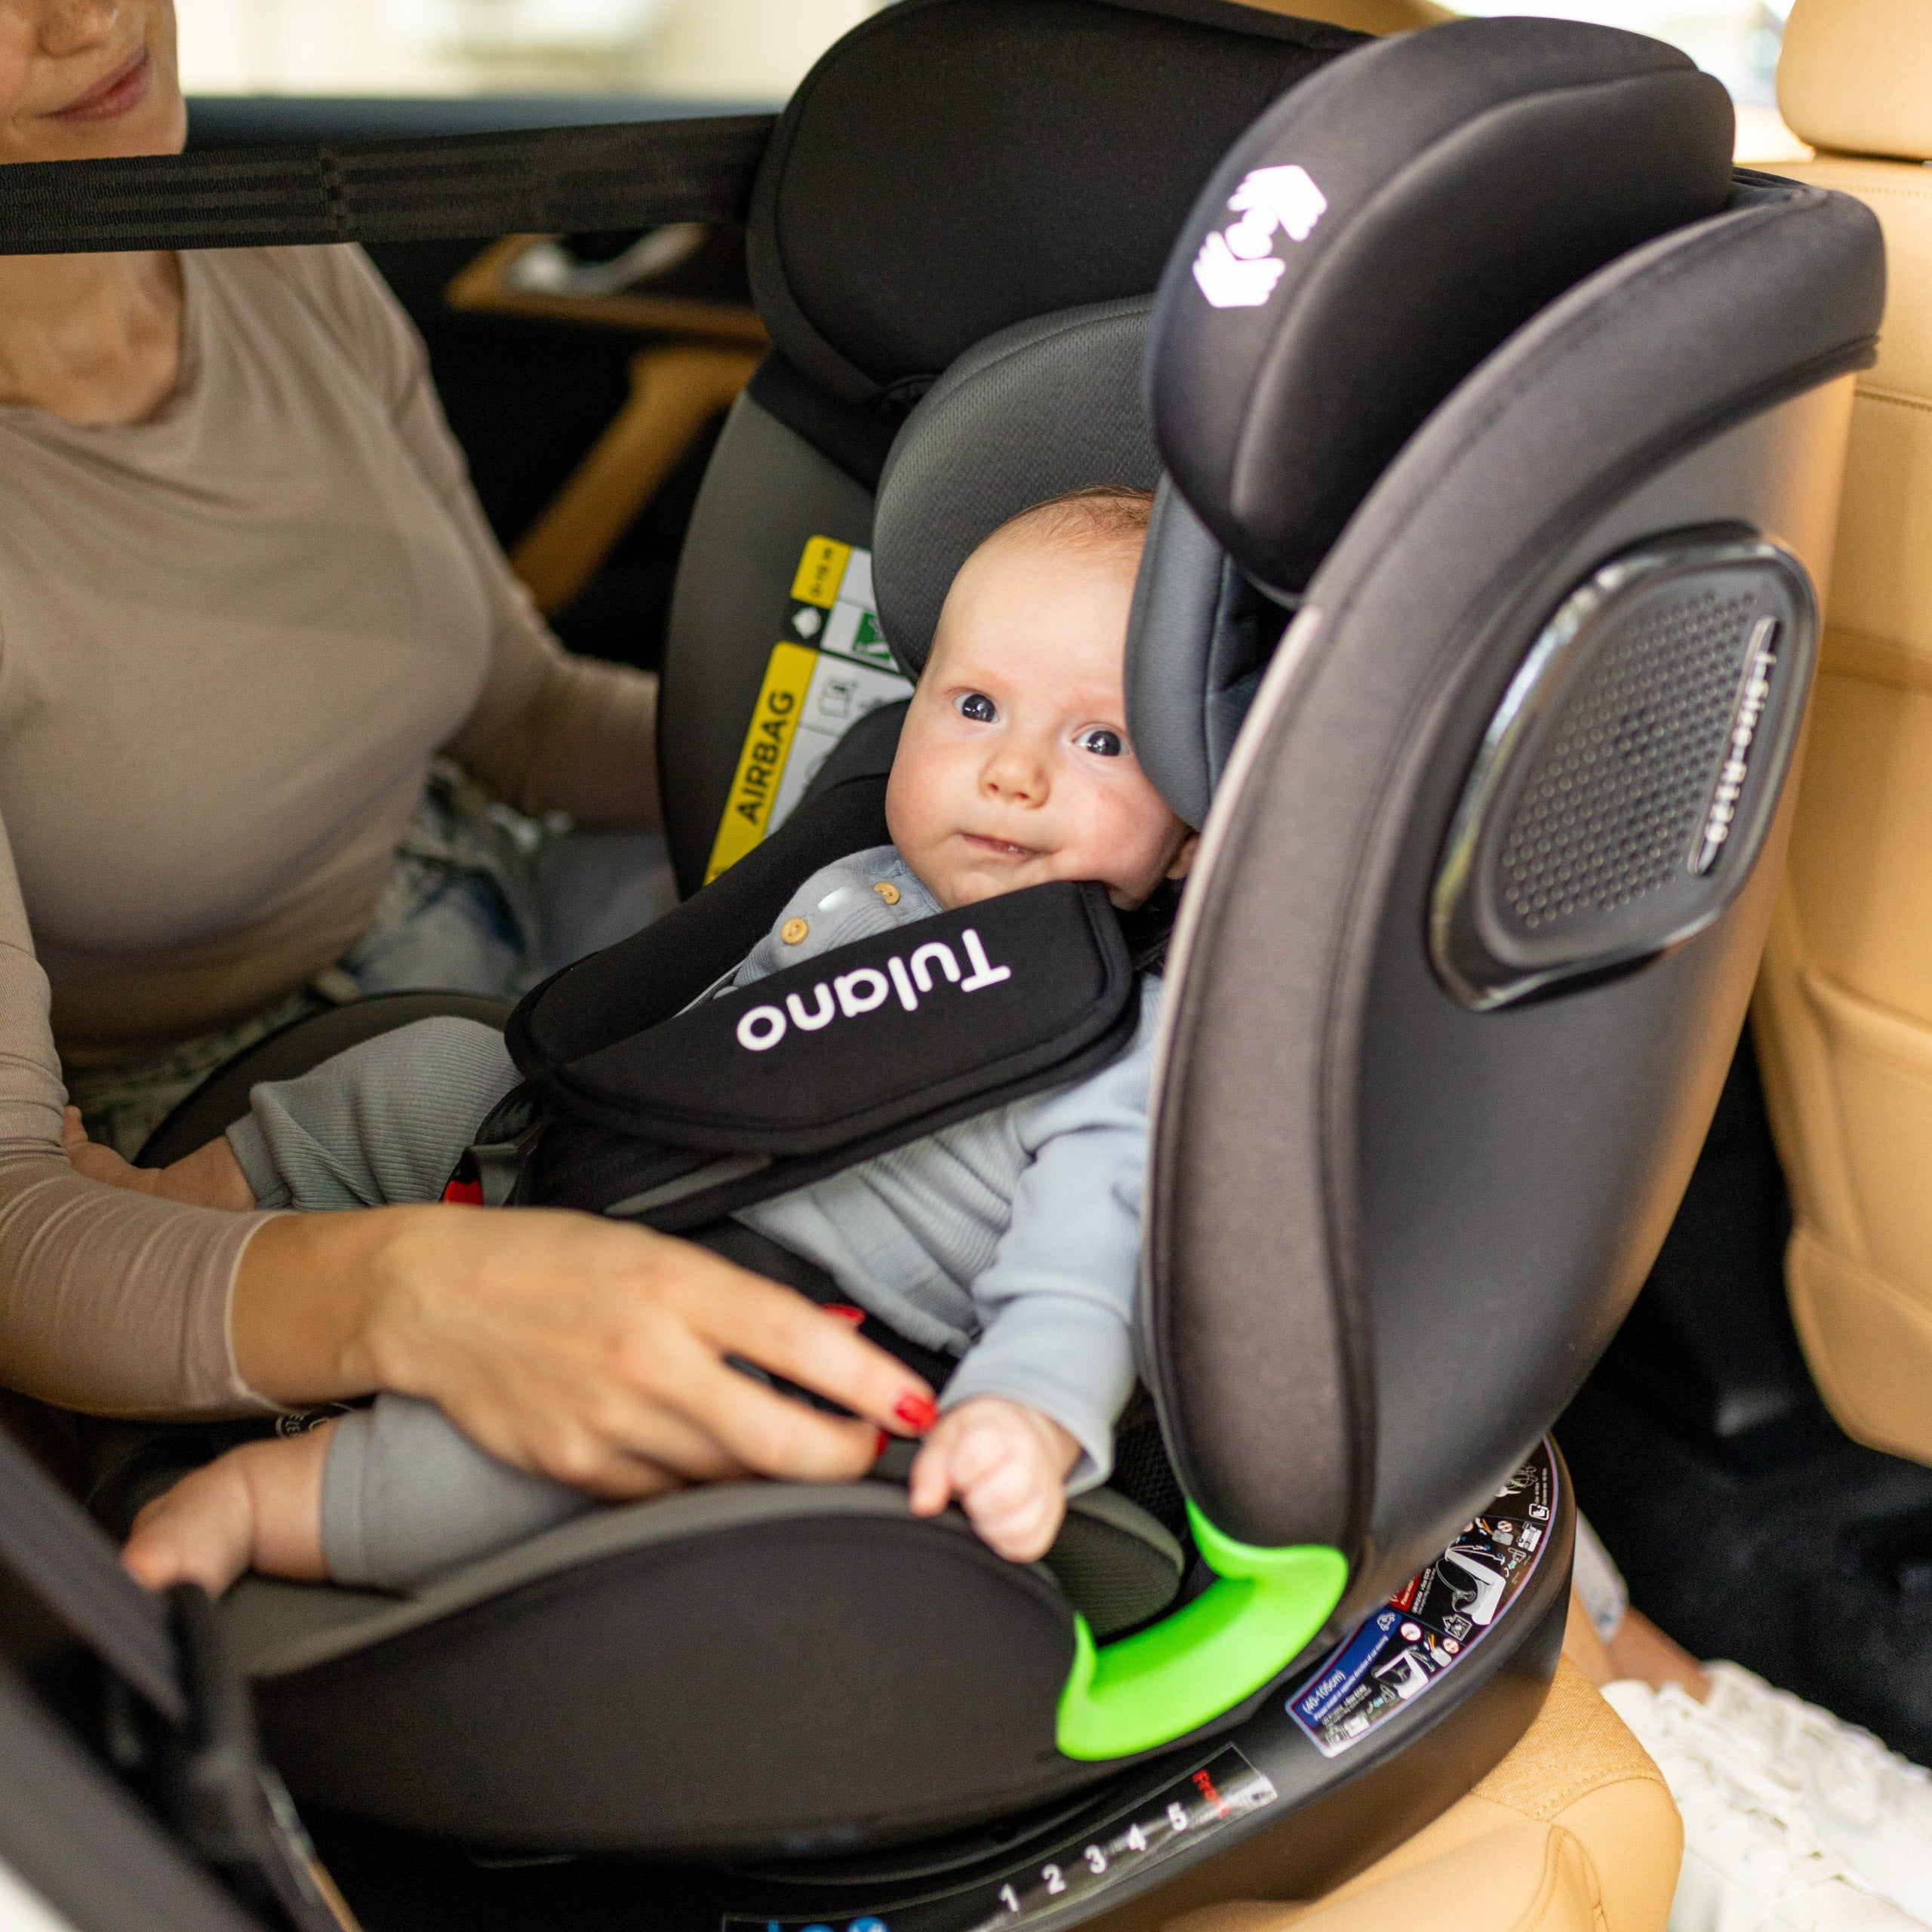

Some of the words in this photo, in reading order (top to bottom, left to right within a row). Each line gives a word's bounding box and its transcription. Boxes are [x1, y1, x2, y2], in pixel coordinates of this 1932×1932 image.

[737, 691, 795, 824] AIRBAG
[737, 928, 1012, 1051] Tulano
[1302, 1669, 1346, 1715] (40-105cm)
[999, 1883, 1020, 1912] 1
[1041, 1863, 1066, 1894] 2
[1084, 1844, 1108, 1874] 3
[1128, 1823, 1146, 1851] 4
[1166, 1801, 1187, 1832] 5
